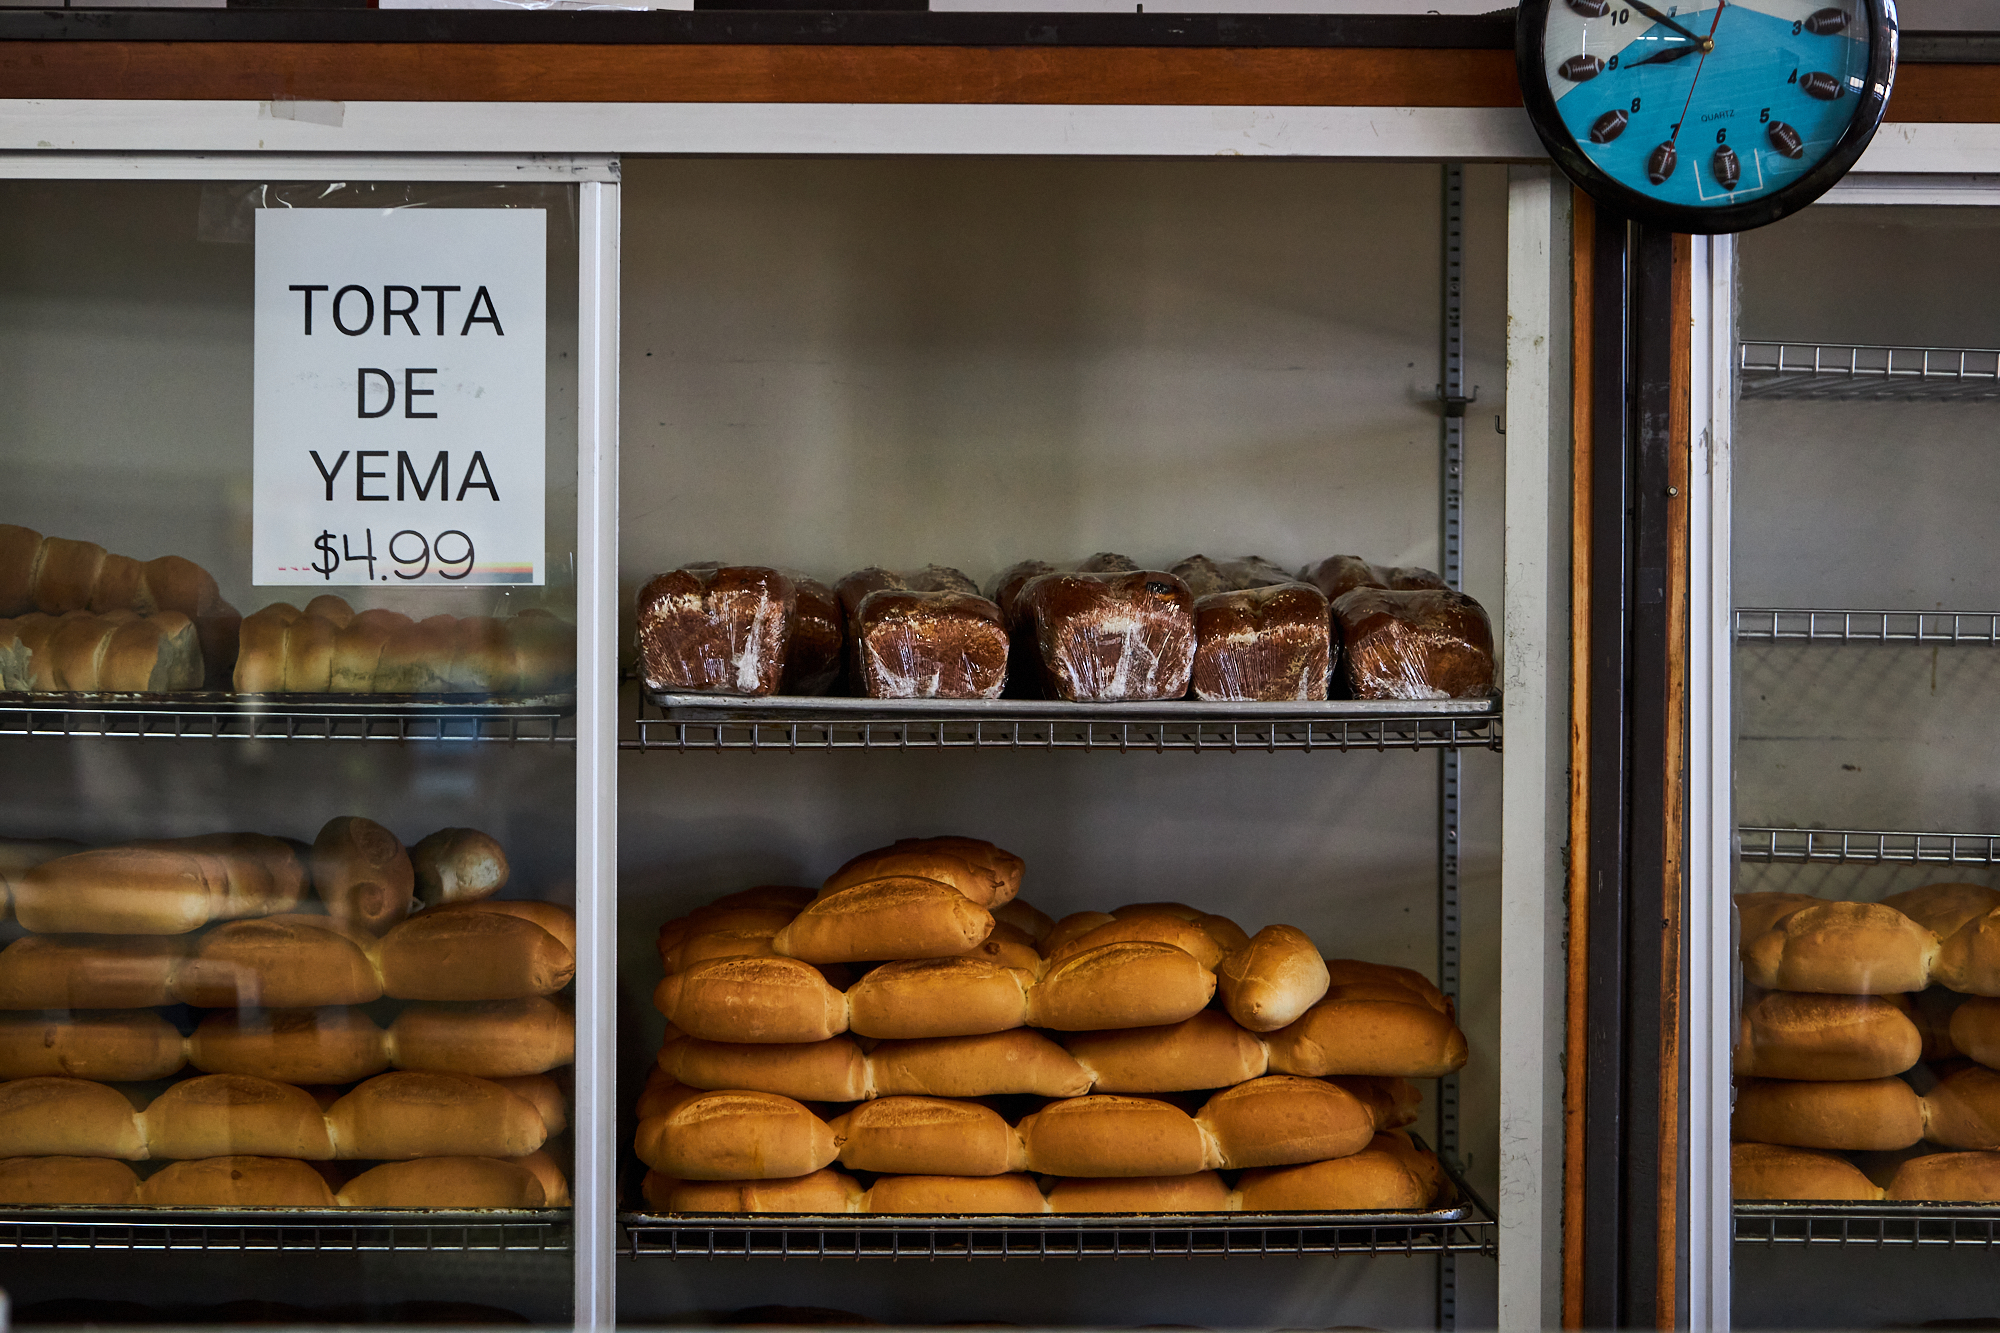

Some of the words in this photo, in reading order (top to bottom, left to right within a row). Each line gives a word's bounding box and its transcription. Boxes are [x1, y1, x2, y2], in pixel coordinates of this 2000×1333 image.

[1611, 9, 1629, 26] 10
[1791, 20, 1802, 36] 3
[1609, 55, 1619, 71] 9
[1787, 68, 1797, 84] 4
[1631, 98, 1641, 113] 8
[1701, 109, 1735, 122] QUARTZ
[1760, 107, 1770, 123] 5
[1671, 123, 1681, 139] 7
[1716, 128, 1726, 144] 6
[288, 284, 505, 336] TORTA
[357, 367, 438, 419] DE
[308, 450, 500, 502] YEMA
[311, 528, 475, 581] $4.99
